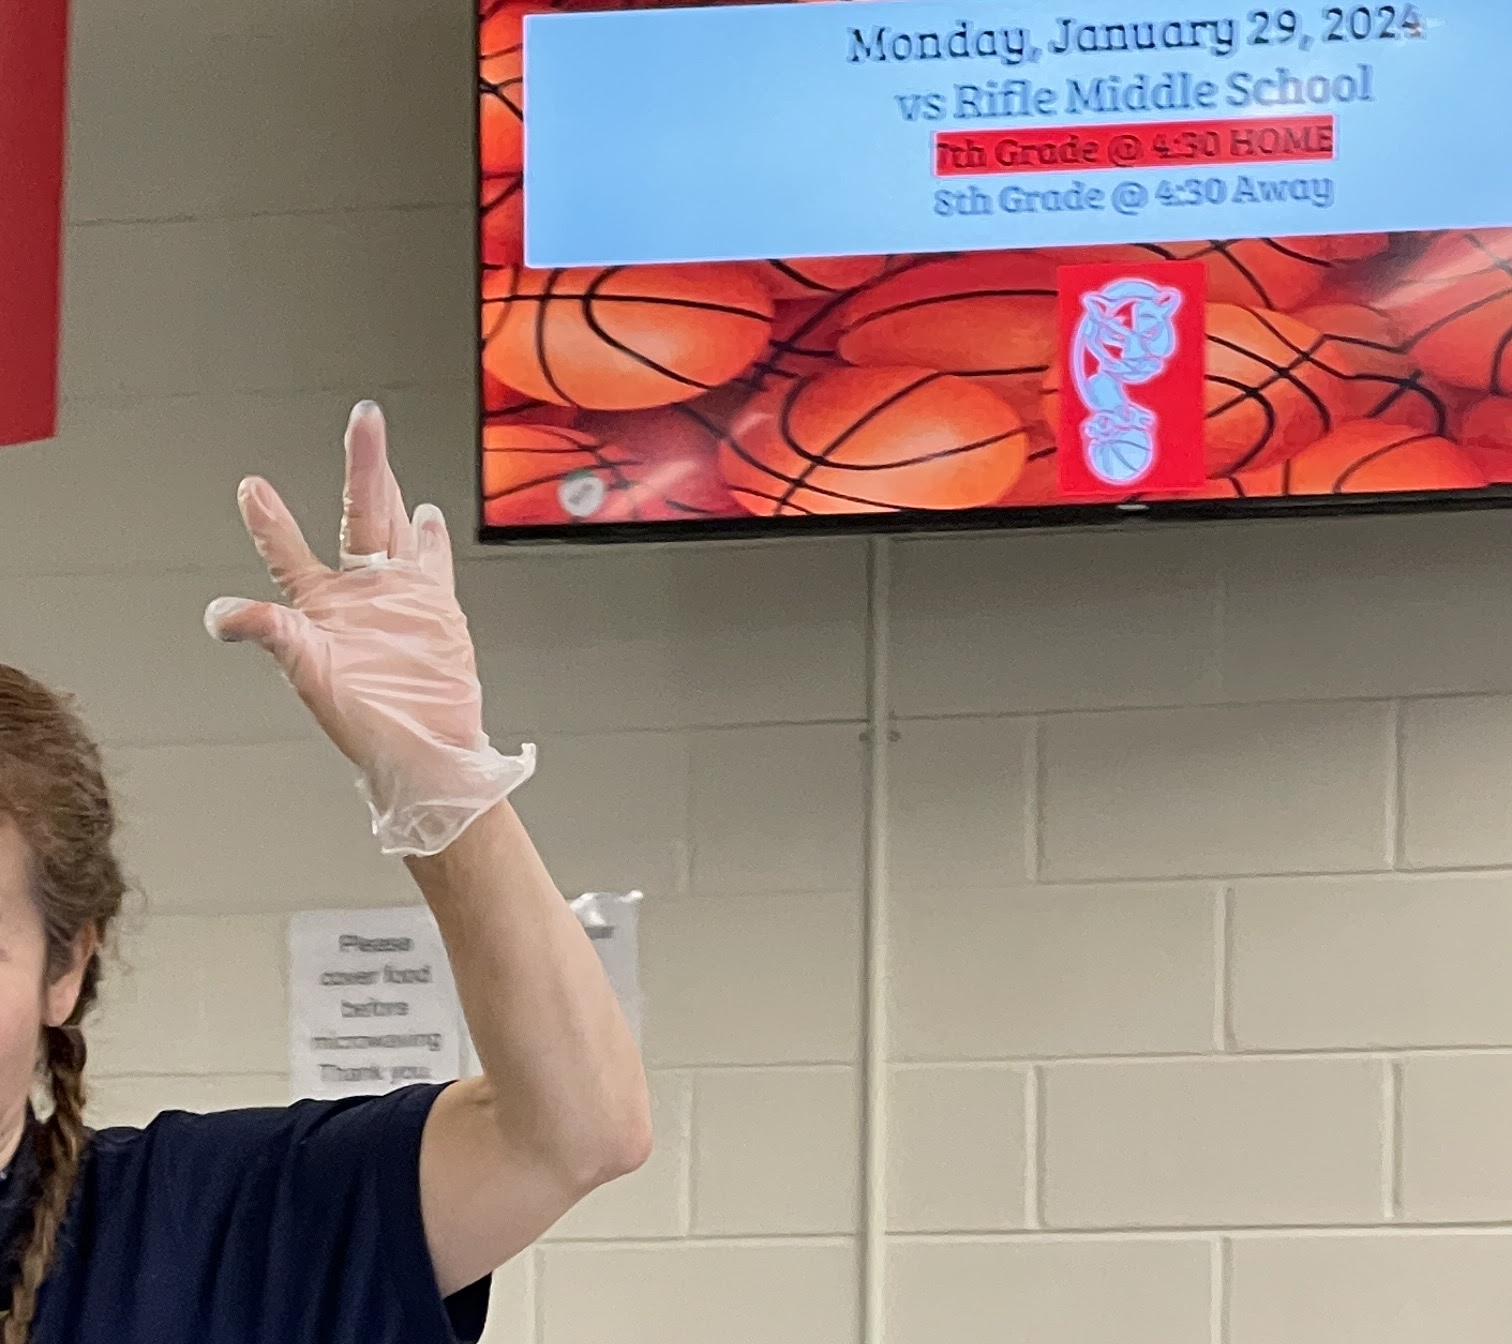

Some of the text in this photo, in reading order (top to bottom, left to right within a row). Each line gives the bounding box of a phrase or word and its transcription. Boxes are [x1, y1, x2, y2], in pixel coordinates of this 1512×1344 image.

[846, 4, 1426, 65] Monday, January 29, 2024
[893, 62, 1376, 121] vs Rifle Middle School
[994, 134, 1099, 167] Grade
[1107, 134, 1143, 168] @
[1151, 130, 1221, 159] 4:30
[1229, 125, 1333, 156] HOME
[933, 175, 1335, 216] 8th Grade @ 4:30 Away
